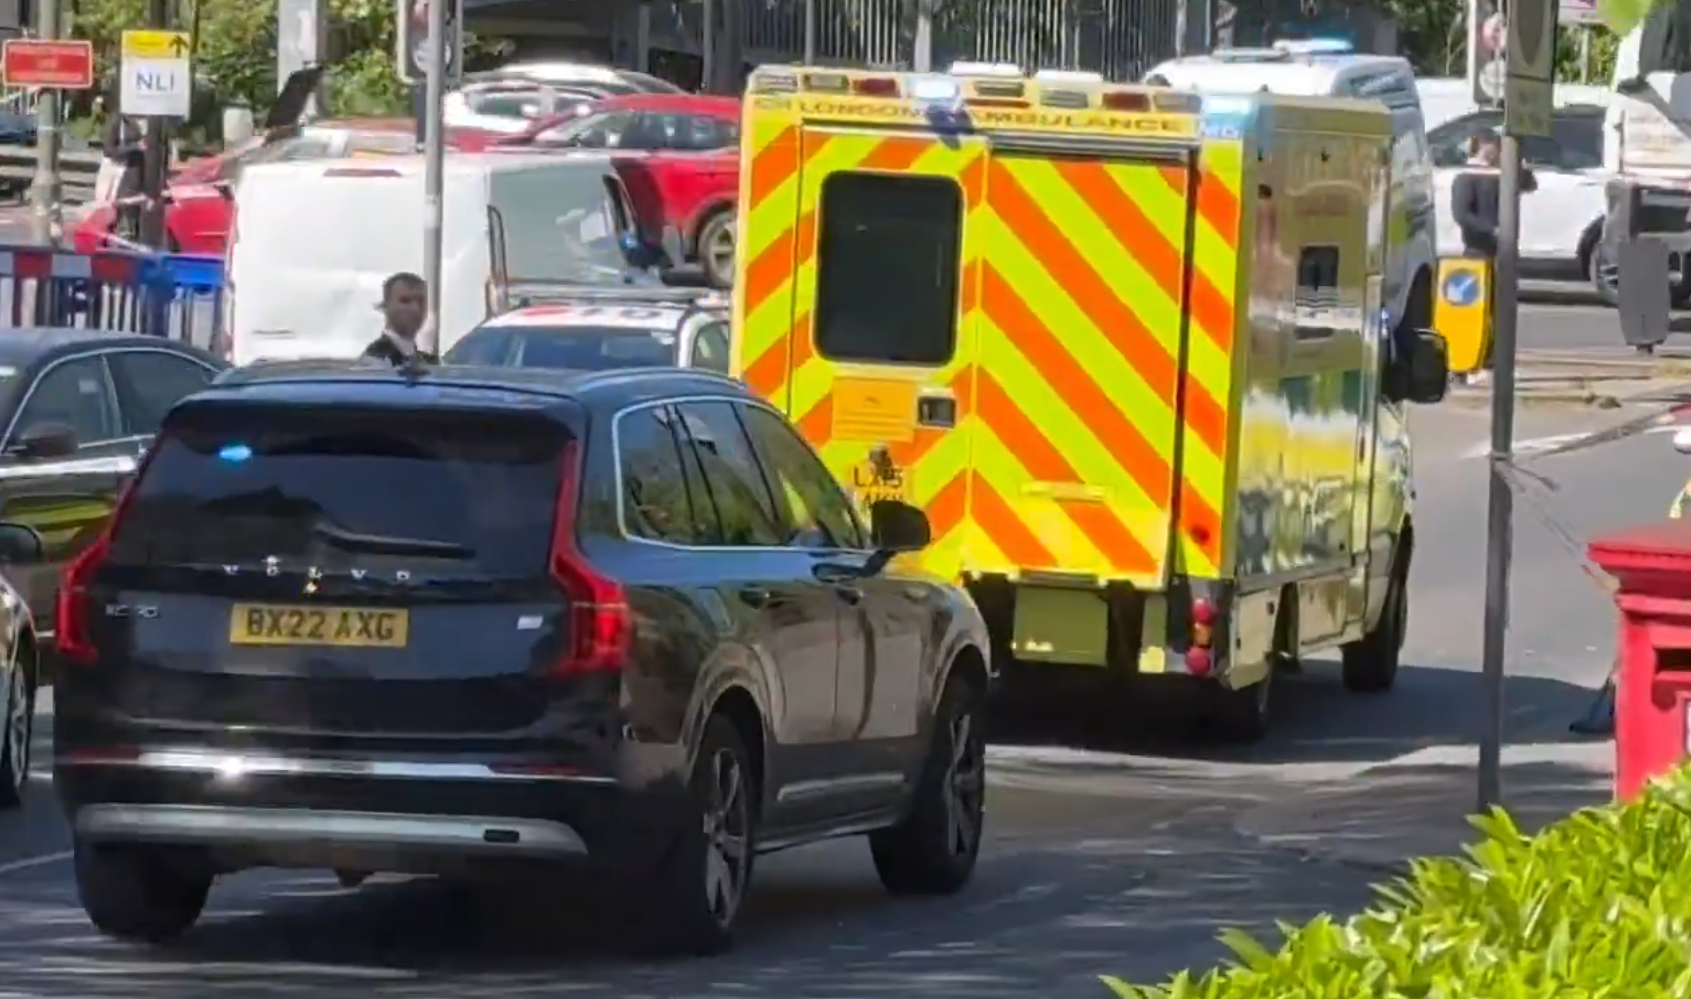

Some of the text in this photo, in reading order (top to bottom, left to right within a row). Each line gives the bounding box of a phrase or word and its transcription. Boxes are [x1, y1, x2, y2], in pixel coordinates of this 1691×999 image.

[136, 72, 174, 91] NLI
[801, 100, 920, 117] LONDON
[223, 563, 411, 581] VOLVO
[247, 608, 395, 641] BX22 AXG
